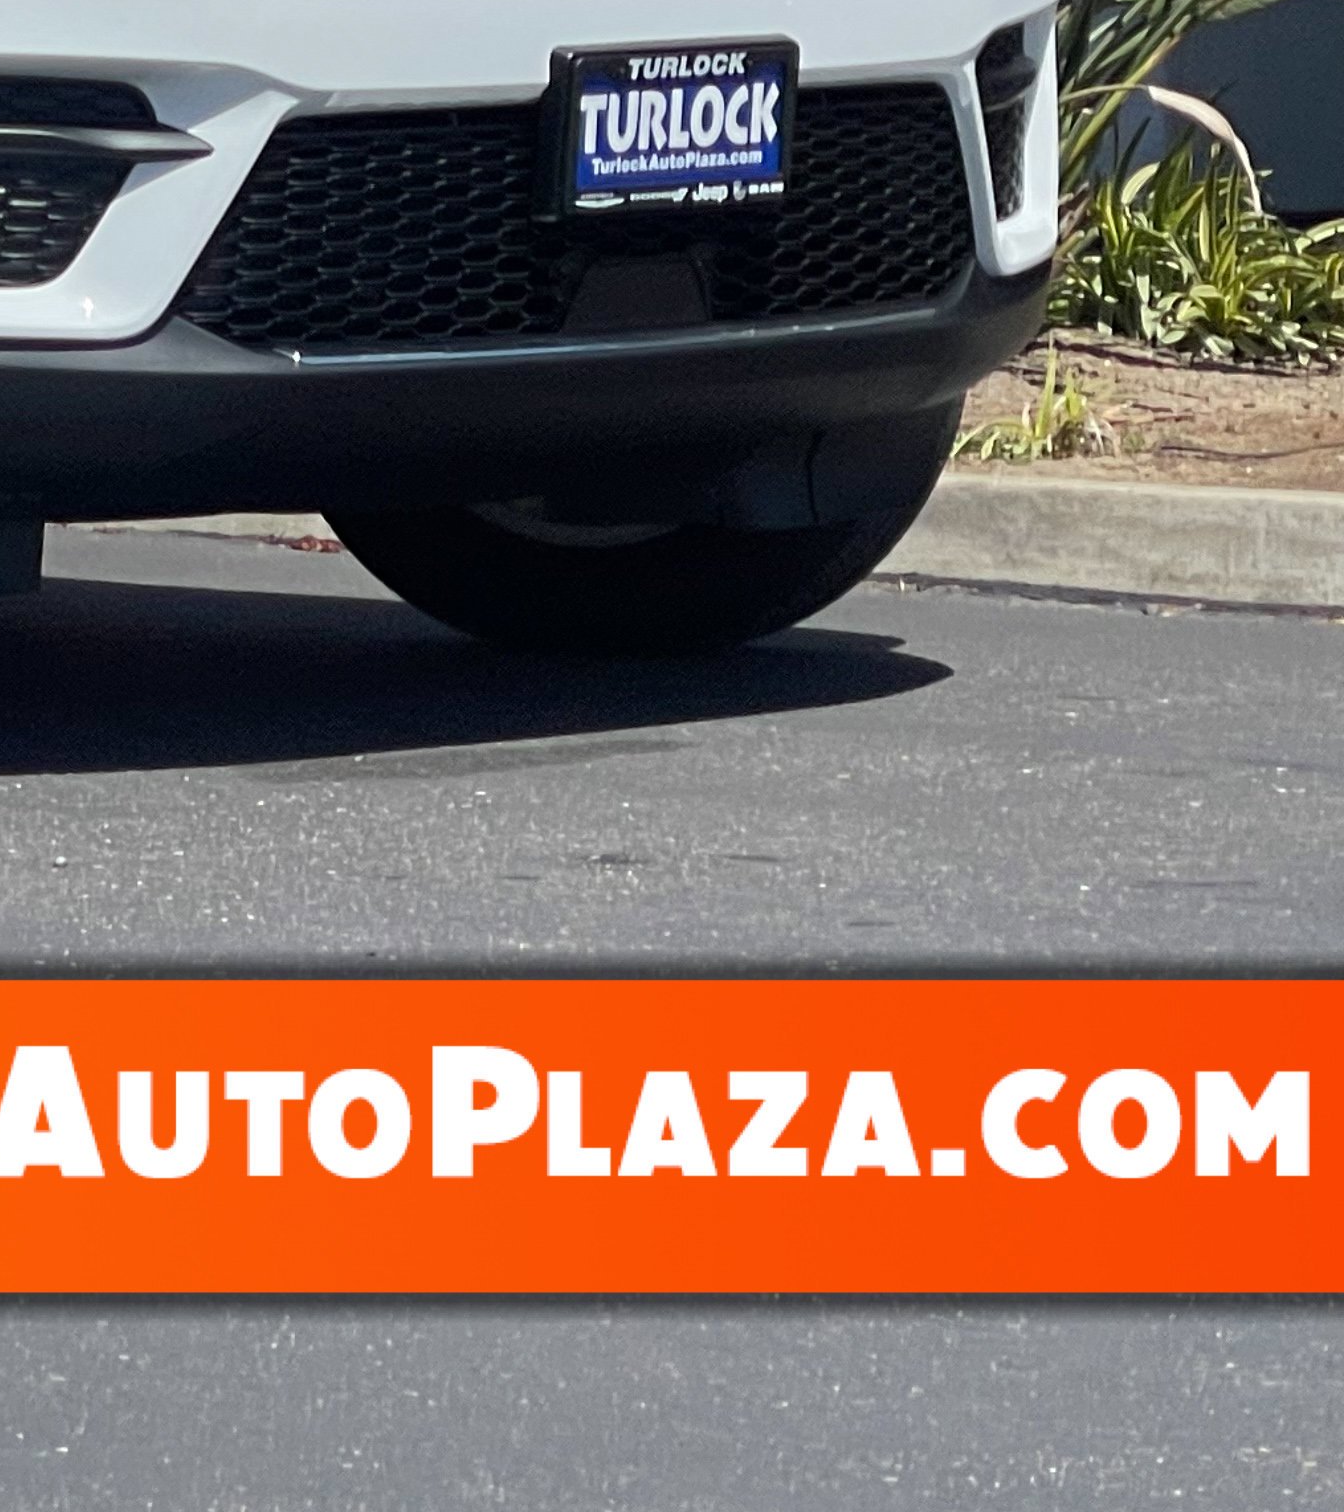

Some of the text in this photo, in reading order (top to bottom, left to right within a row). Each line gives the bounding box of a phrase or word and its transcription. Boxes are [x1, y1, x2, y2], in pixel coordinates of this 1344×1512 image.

[628, 52, 748, 80] TURLOCK
[580, 82, 780, 154] TURLOCK
[592, 150, 762, 175] TurlockAutoPlaza.com
